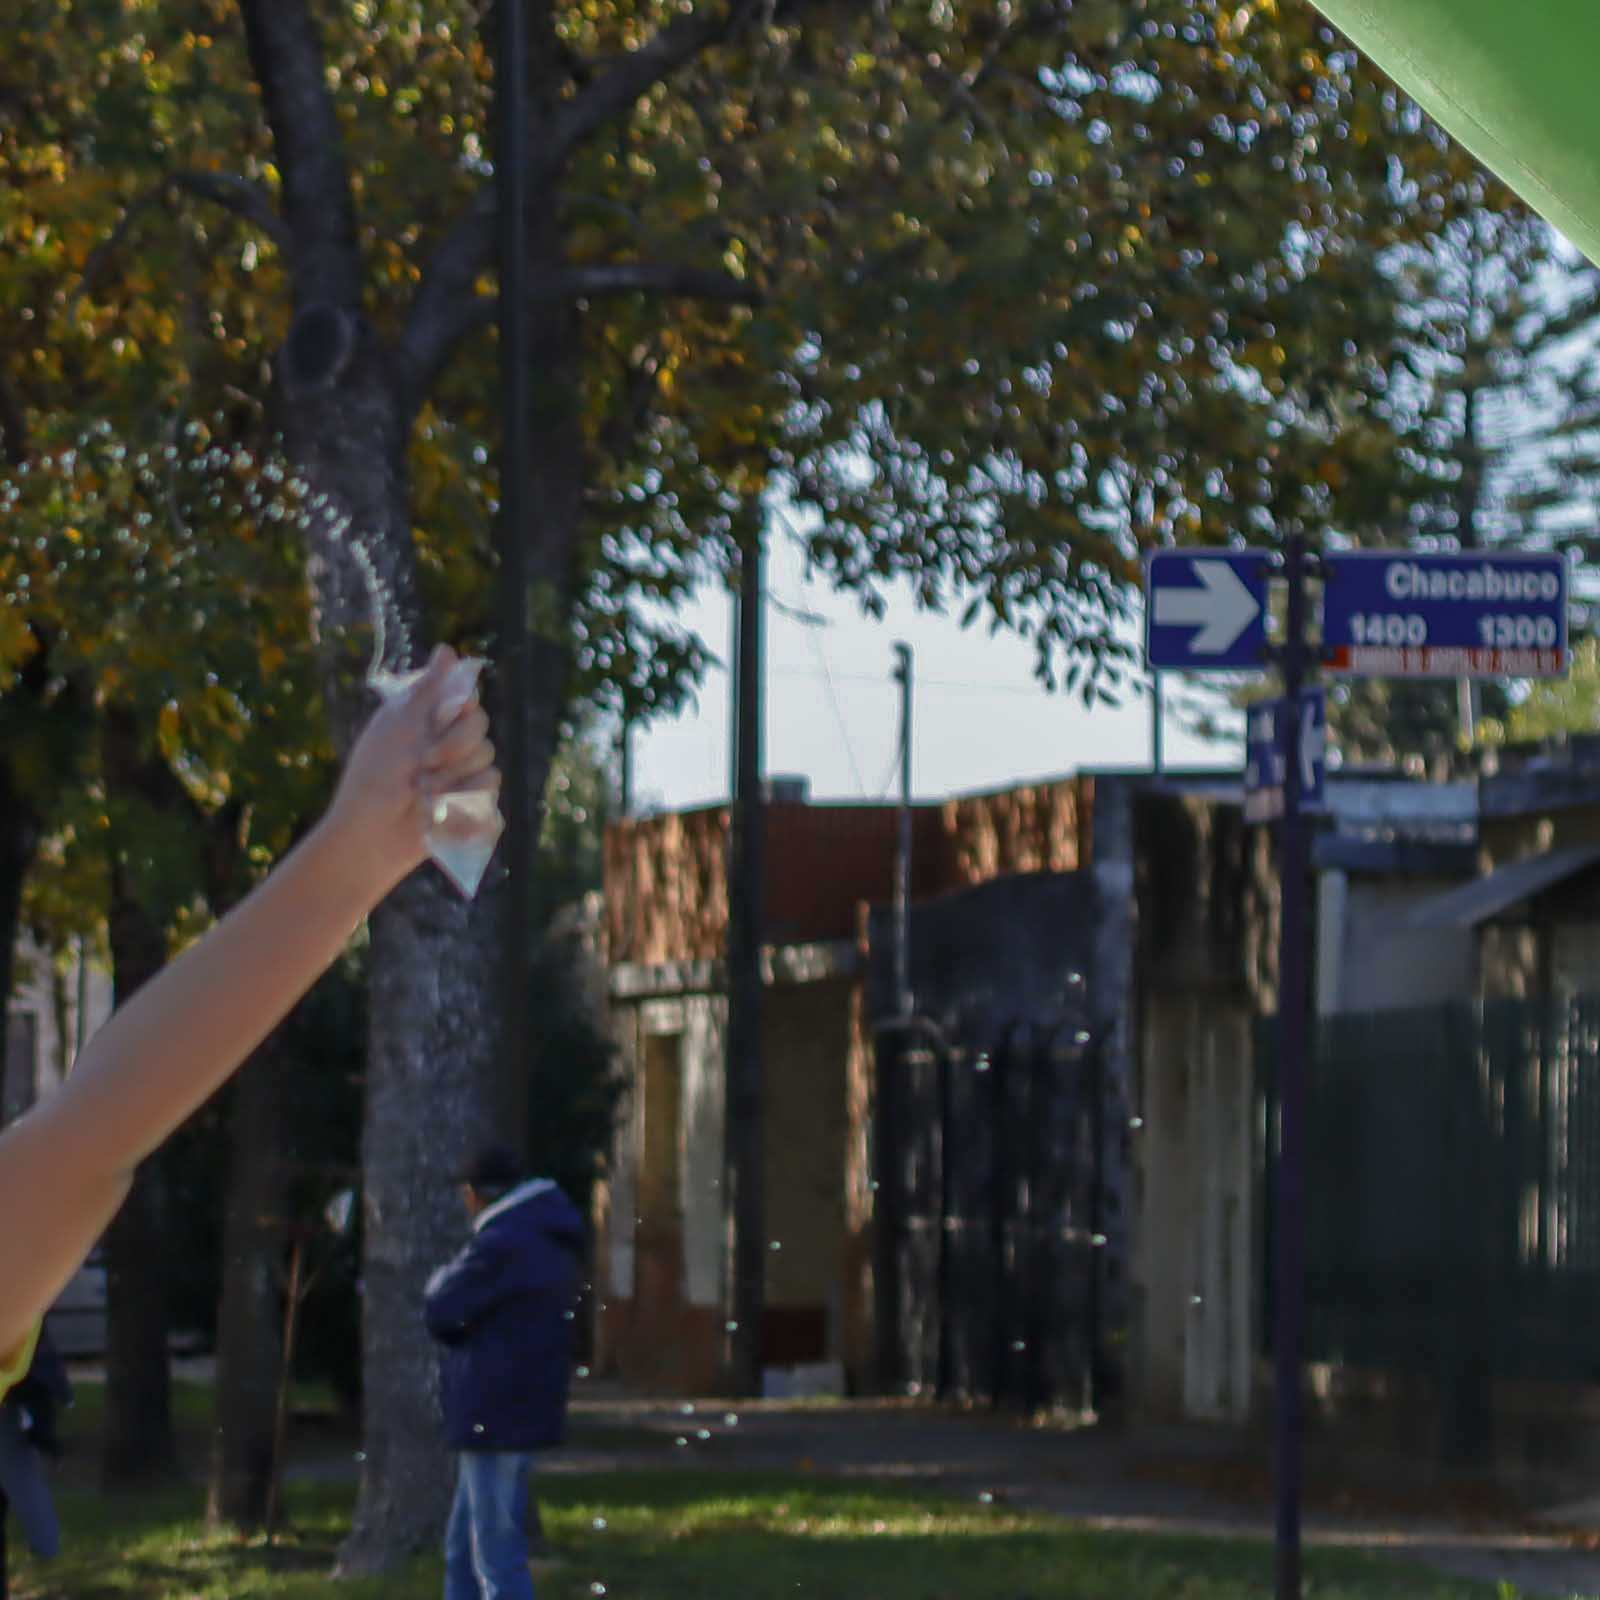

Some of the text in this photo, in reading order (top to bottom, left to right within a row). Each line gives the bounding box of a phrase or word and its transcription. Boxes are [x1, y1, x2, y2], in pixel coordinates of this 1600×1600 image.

[1386, 562, 1560, 600] Chacabuco
[1350, 614, 1557, 646] 1400 1300
